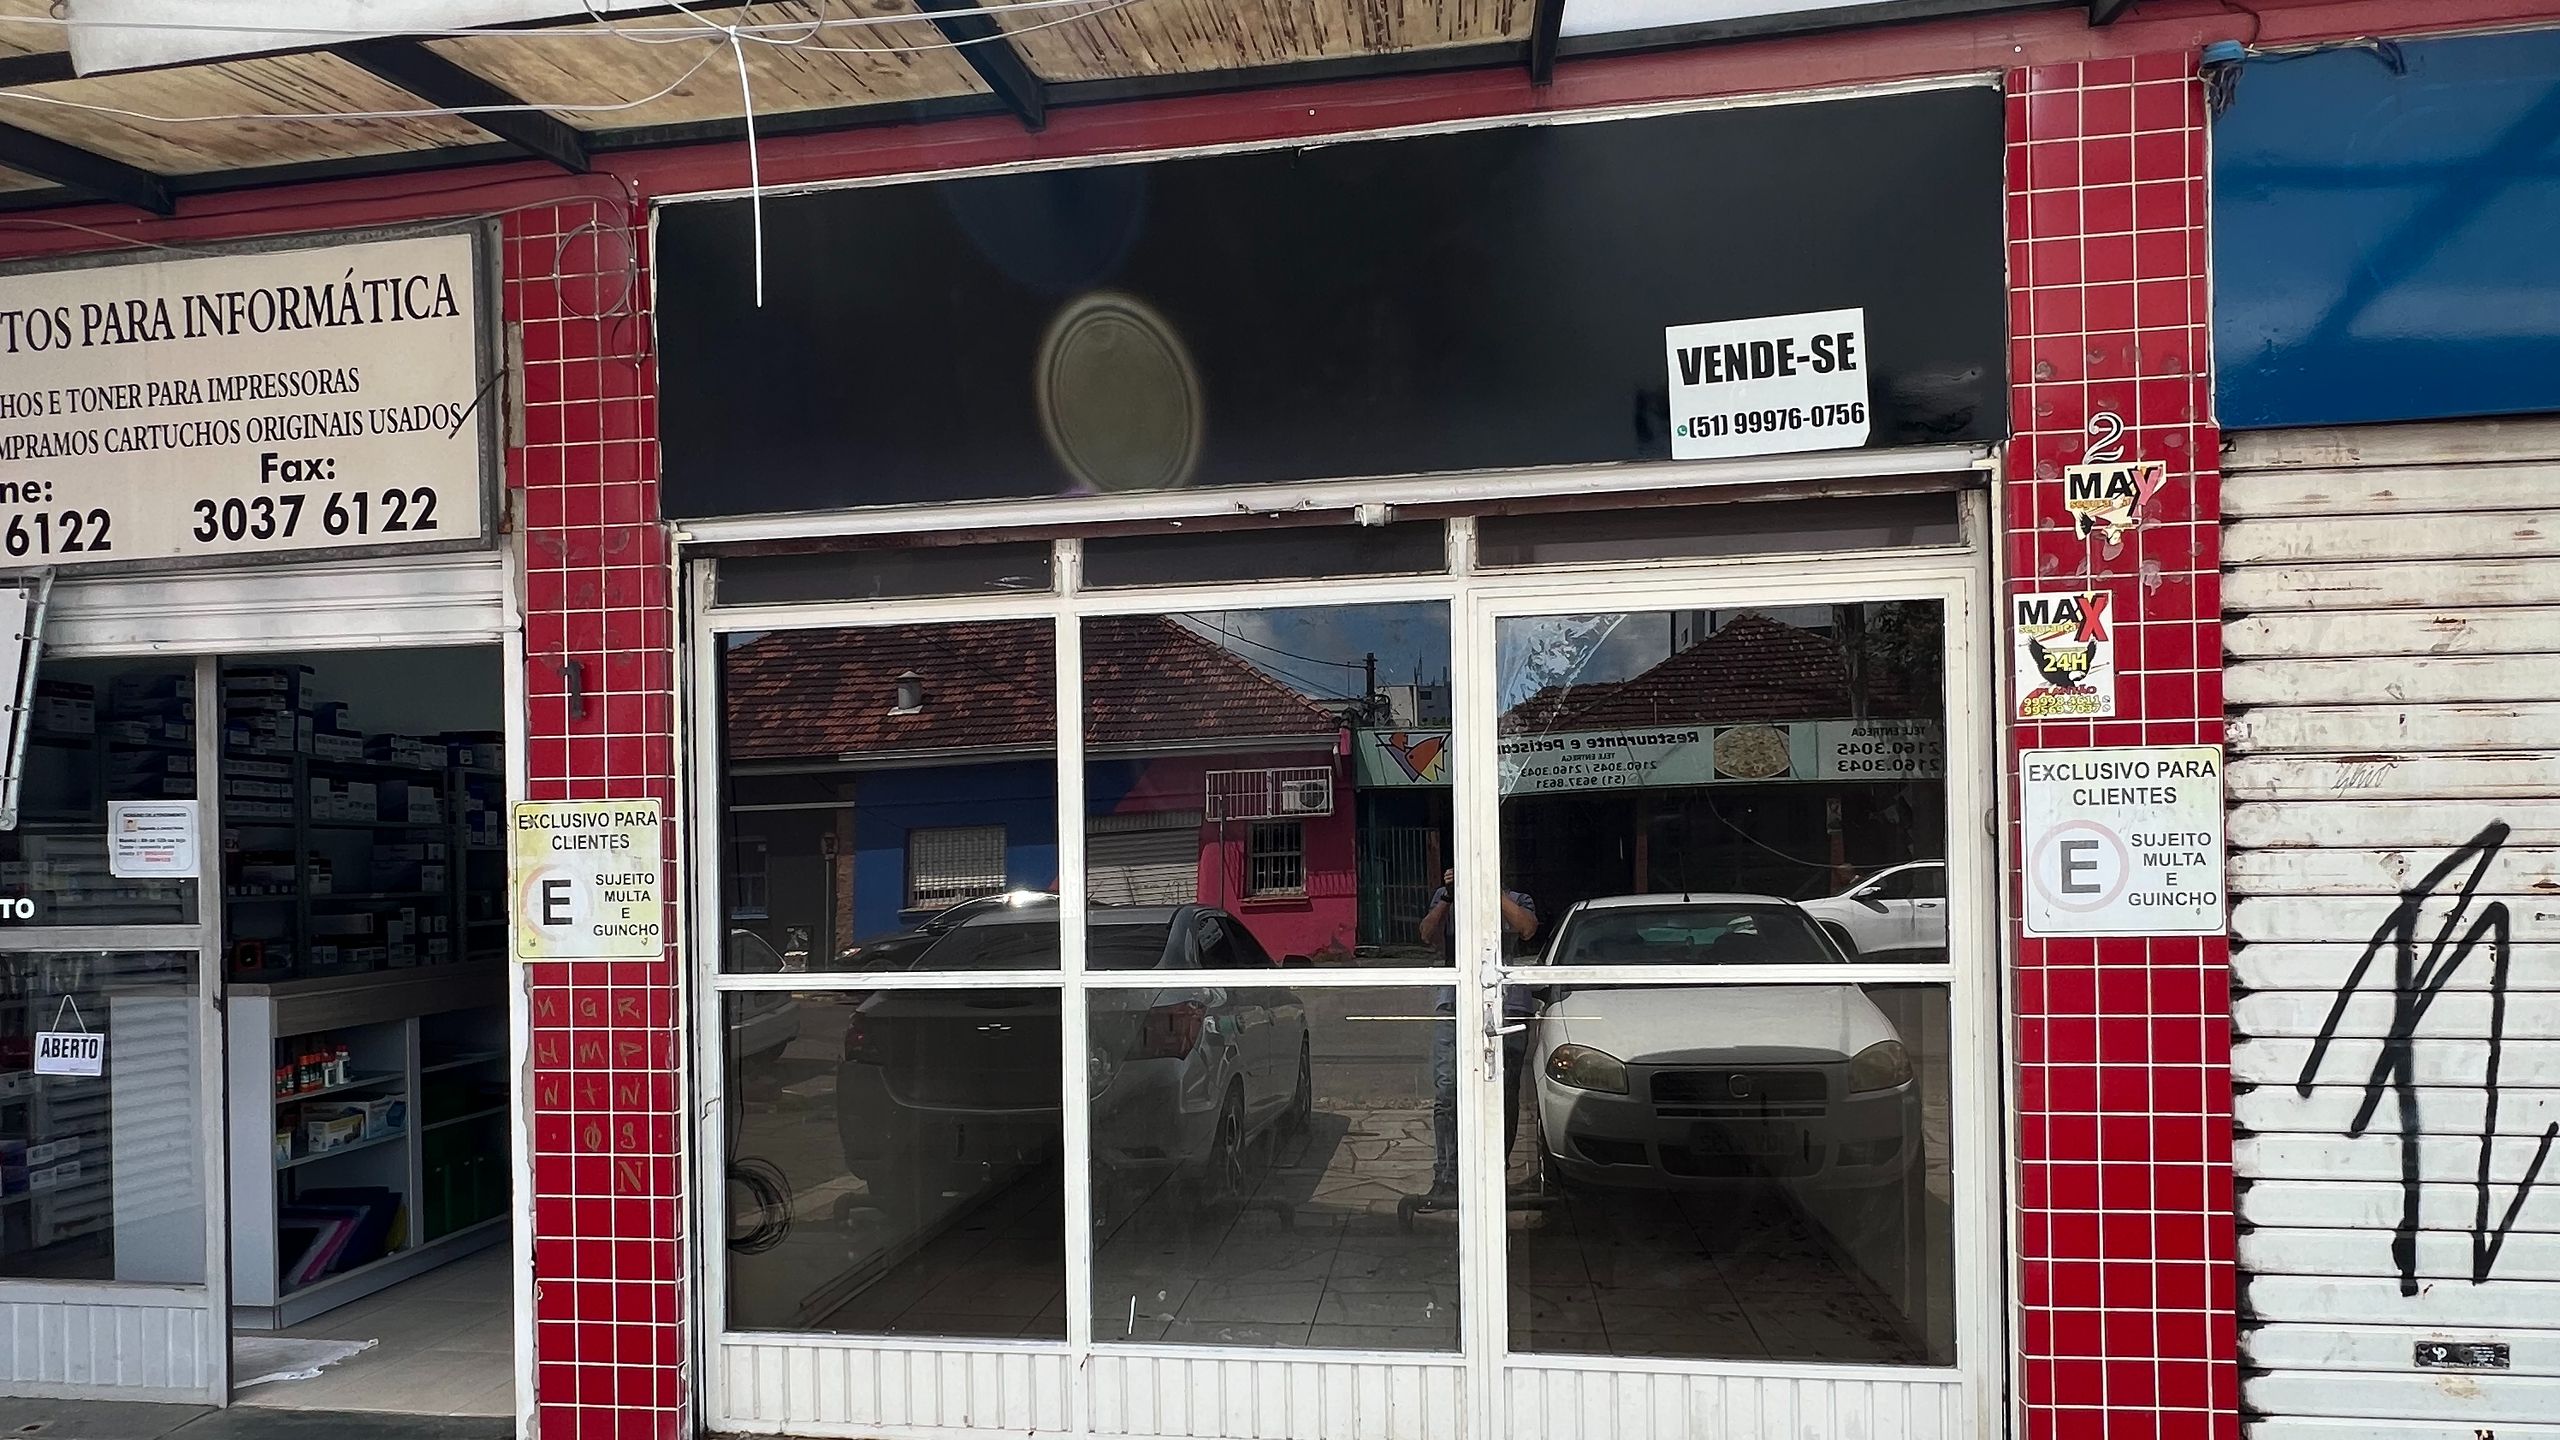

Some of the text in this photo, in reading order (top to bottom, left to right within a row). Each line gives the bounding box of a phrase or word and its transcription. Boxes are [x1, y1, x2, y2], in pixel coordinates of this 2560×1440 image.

[0, 267, 460, 353] TOS PARA INFORMÁTICA
[1676, 331, 1857, 386] VENDE-SE
[0, 367, 360, 419] HOS E TONER PARA IMPRESSORAS
[104, 419, 241, 453] CARTUCHOS
[246, 410, 363, 443] ORIGINAIS
[369, 402, 462, 435] USADOS
[1689, 402, 1865, 439] (51) 99976-0756
[2082, 411, 2124, 465] 2
[261, 452, 336, 484] Fax:
[193, 487, 438, 542] 3037 6122
[5, 508, 112, 557] 6122
[2018, 592, 2110, 643] MAX
[2043, 652, 2088, 673] 24H
[2028, 760, 2216, 782] EXCLUSIVO PARA
[2073, 787, 2177, 806] CLIENTES
[519, 811, 658, 829] EXCLUSIVO PARA
[552, 834, 630, 850] CLIENTES
[2131, 832, 2212, 847] SUJEITO
[2060, 839, 2101, 894] E
[2144, 853, 2206, 866] MULTA
[595, 873, 655, 886] SUJEITO
[2166, 872, 2177, 886] E
[542, 879, 573, 926] E
[604, 890, 651, 902] MULTA
[2128, 892, 2217, 907] GUINCHO
[0, 898, 35, 919] TO
[621, 907, 630, 919] E
[593, 923, 659, 936] GUINCHO
[40, 1037, 99, 1059] ABERTO
